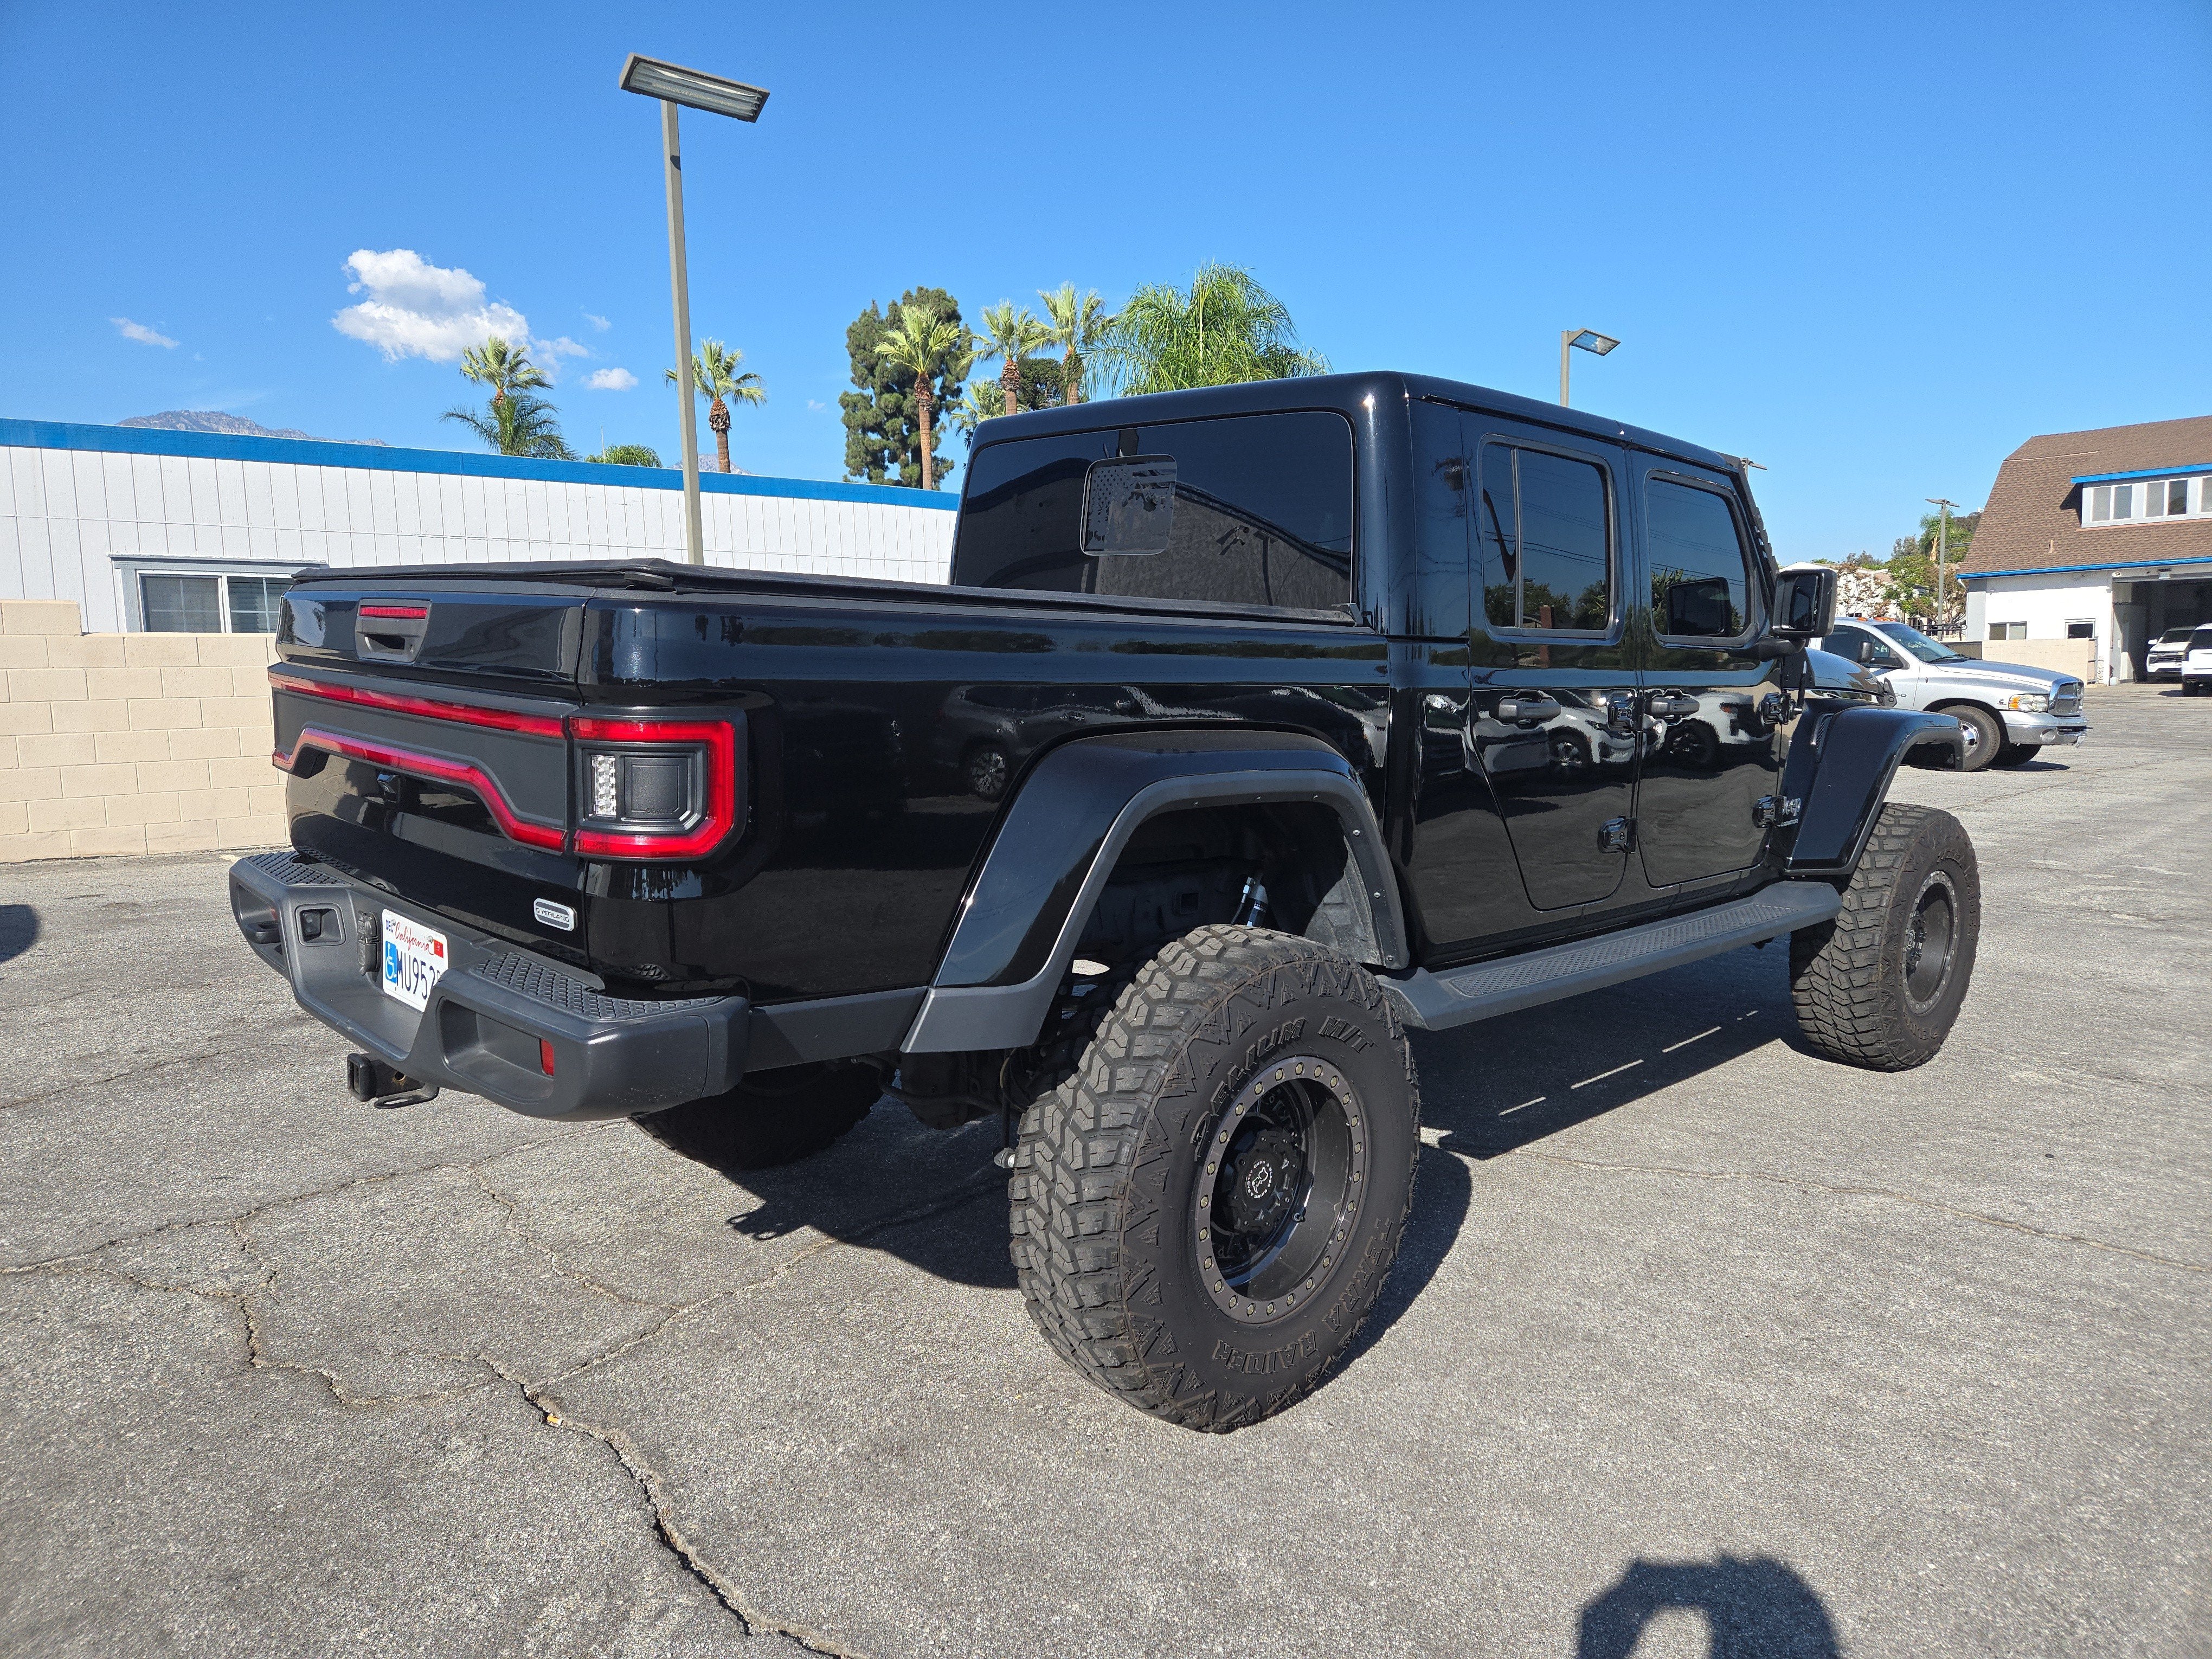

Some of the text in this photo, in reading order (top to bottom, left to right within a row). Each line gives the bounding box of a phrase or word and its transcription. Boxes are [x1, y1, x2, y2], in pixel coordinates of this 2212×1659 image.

[535, 908, 570, 922] OVERLAND
[395, 922, 434, 955] California
[1318, 1015, 1375, 1053] M/T
